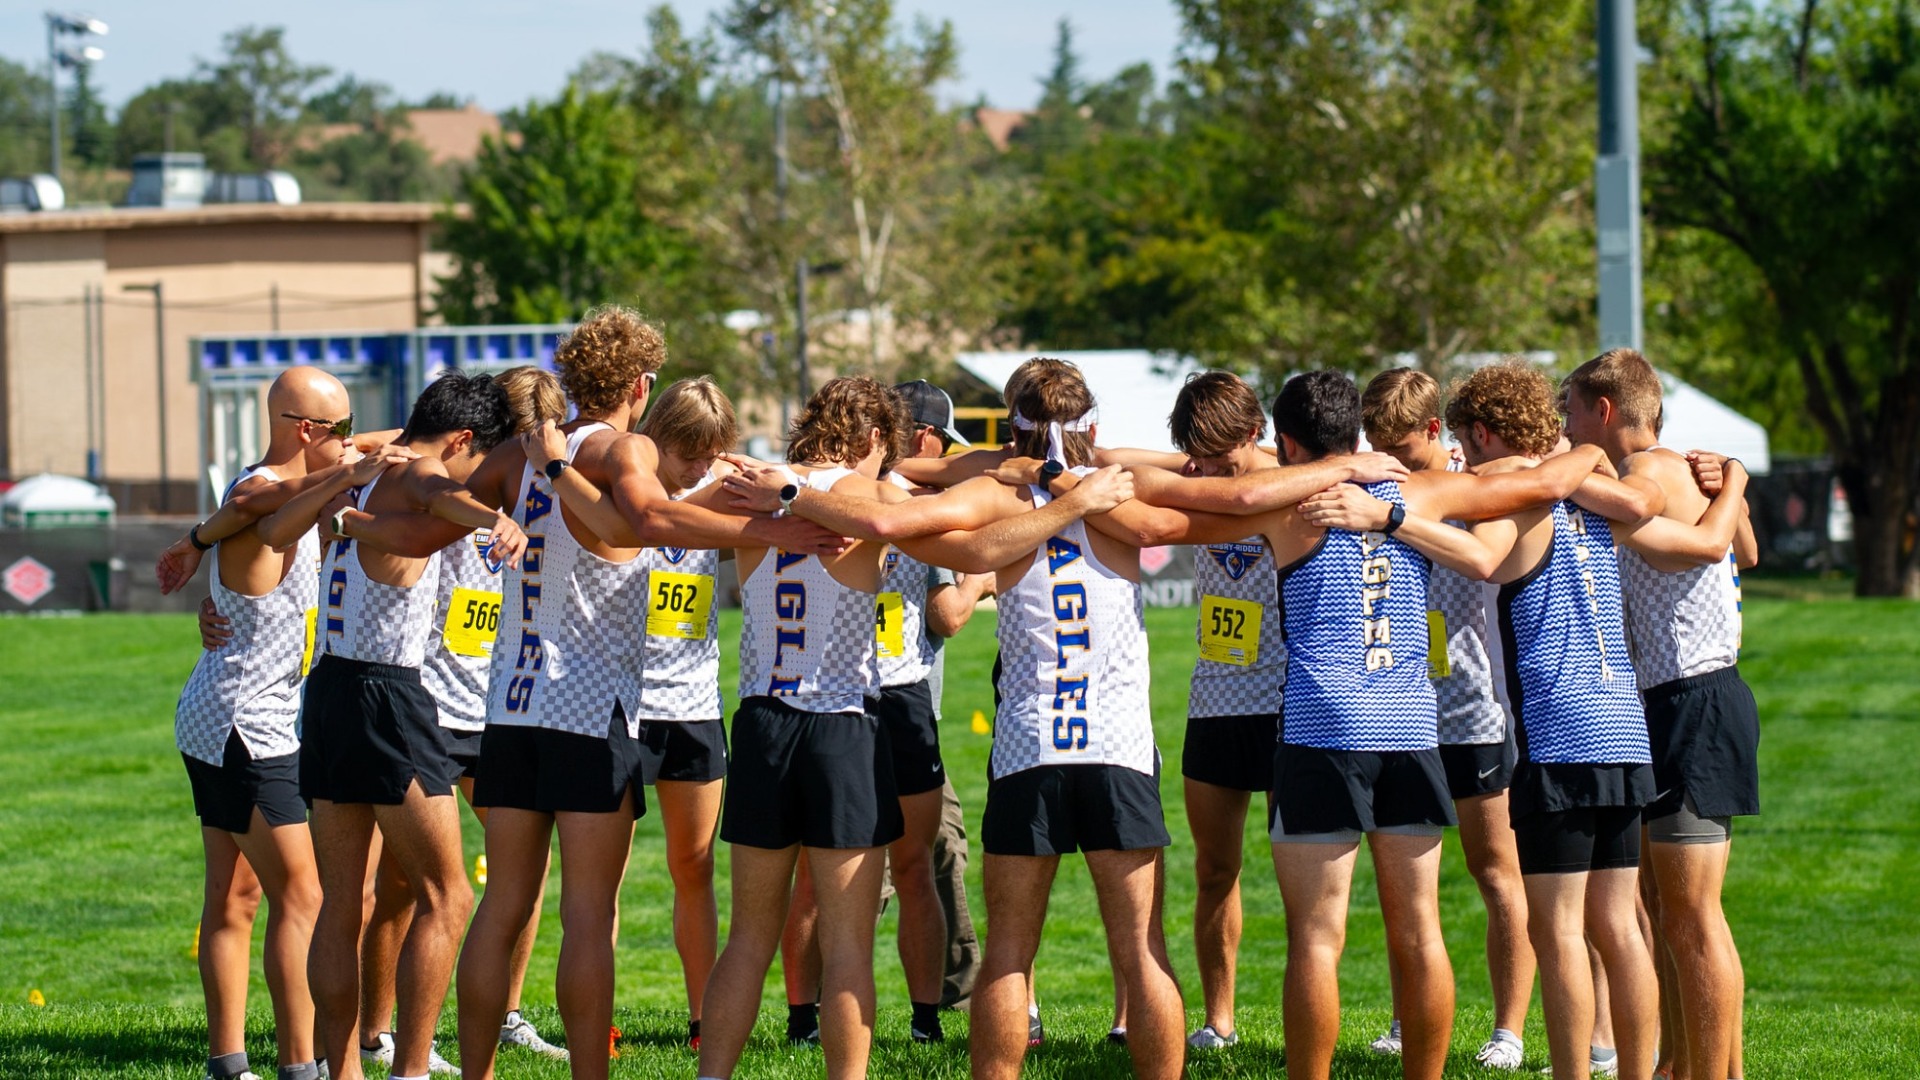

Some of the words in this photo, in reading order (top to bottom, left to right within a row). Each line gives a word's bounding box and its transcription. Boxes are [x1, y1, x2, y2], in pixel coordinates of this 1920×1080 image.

[463, 600, 500, 632] 566
[505, 471, 554, 714] AGLES
[656, 582, 697, 613] 562
[1211, 606, 1245, 640] 552
[1361, 531, 1394, 672] AGLES
[1047, 536, 1090, 752] AGLES
